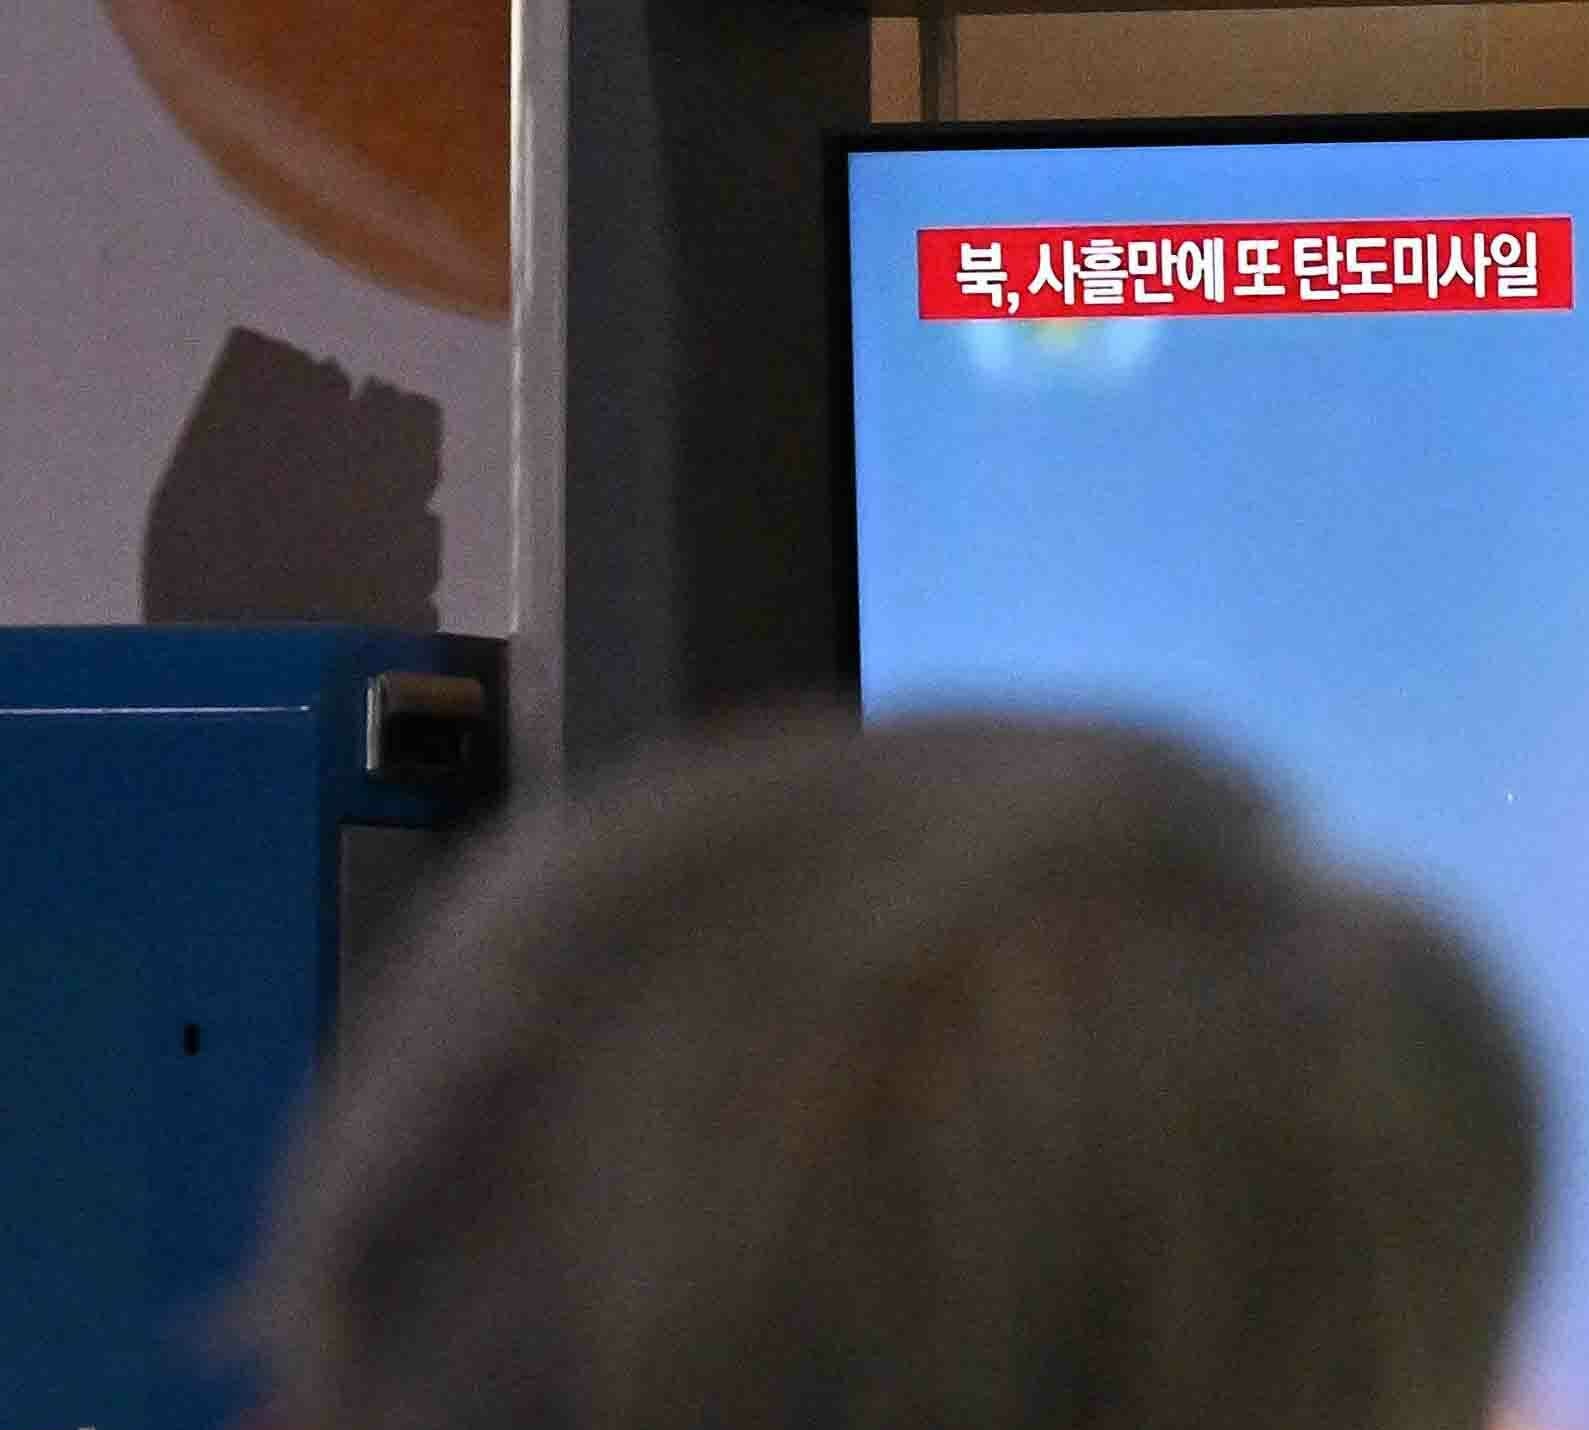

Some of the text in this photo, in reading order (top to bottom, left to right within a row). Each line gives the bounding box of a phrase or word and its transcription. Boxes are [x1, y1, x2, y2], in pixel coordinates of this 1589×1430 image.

[956, 231, 1538, 314] 북, 사흘만에 또 탄도미사일
